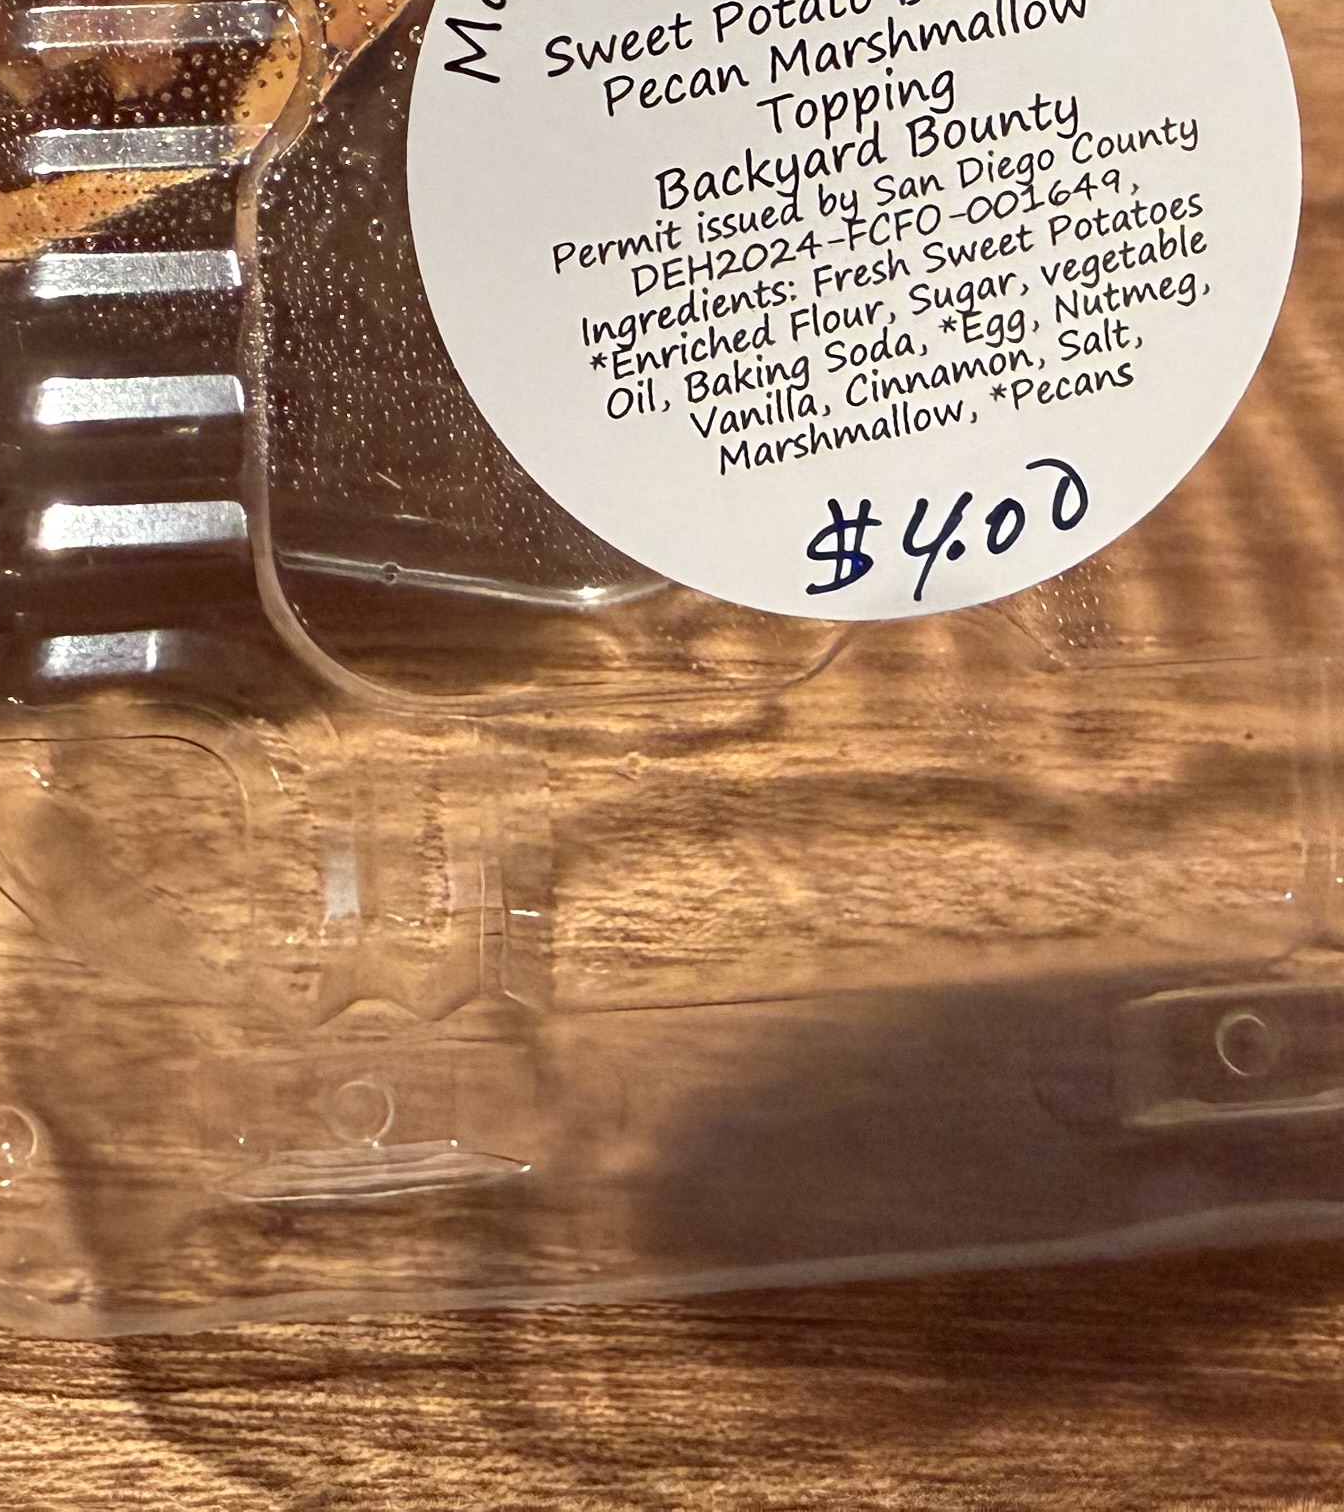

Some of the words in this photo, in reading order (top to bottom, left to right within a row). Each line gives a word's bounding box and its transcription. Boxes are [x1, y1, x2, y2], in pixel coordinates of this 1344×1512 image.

[545, 12, 693, 78] Sweet
[603, 64, 749, 117] Pecan
[756, 66, 955, 139] Topping
[552, 219, 682, 274] Permit
[697, 194, 803, 244] issued
[818, 182, 859, 223] by
[873, 172, 945, 206] San
[957, 148, 1054, 189] Diego
[1071, 116, 1199, 164] County
[655, 120, 887, 210] Backyard
[906, 92, 1079, 158] Bounty
[581, 281, 797, 346] Ingredients:
[813, 249, 911, 297] Fresh
[921, 224, 1034, 273] Sweet
[1048, 192, 1204, 246] Potatoes
[790, 301, 896, 341] Flour,
[909, 271, 1029, 315] Sugar,
[1040, 224, 1207, 288] vegetable
[606, 377, 671, 420] Oil,
[684, 353, 810, 403] Baking
[824, 326, 928, 373] Soda,
[1055, 272, 1211, 323] Nutmeg,
[689, 387, 831, 438] Vanilla,
[845, 349, 1046, 407] Cinnamon,
[1058, 317, 1143, 361] Salt,
[719, 399, 978, 476] Marshmallow,
[805, 457, 1089, 601] $4.00
